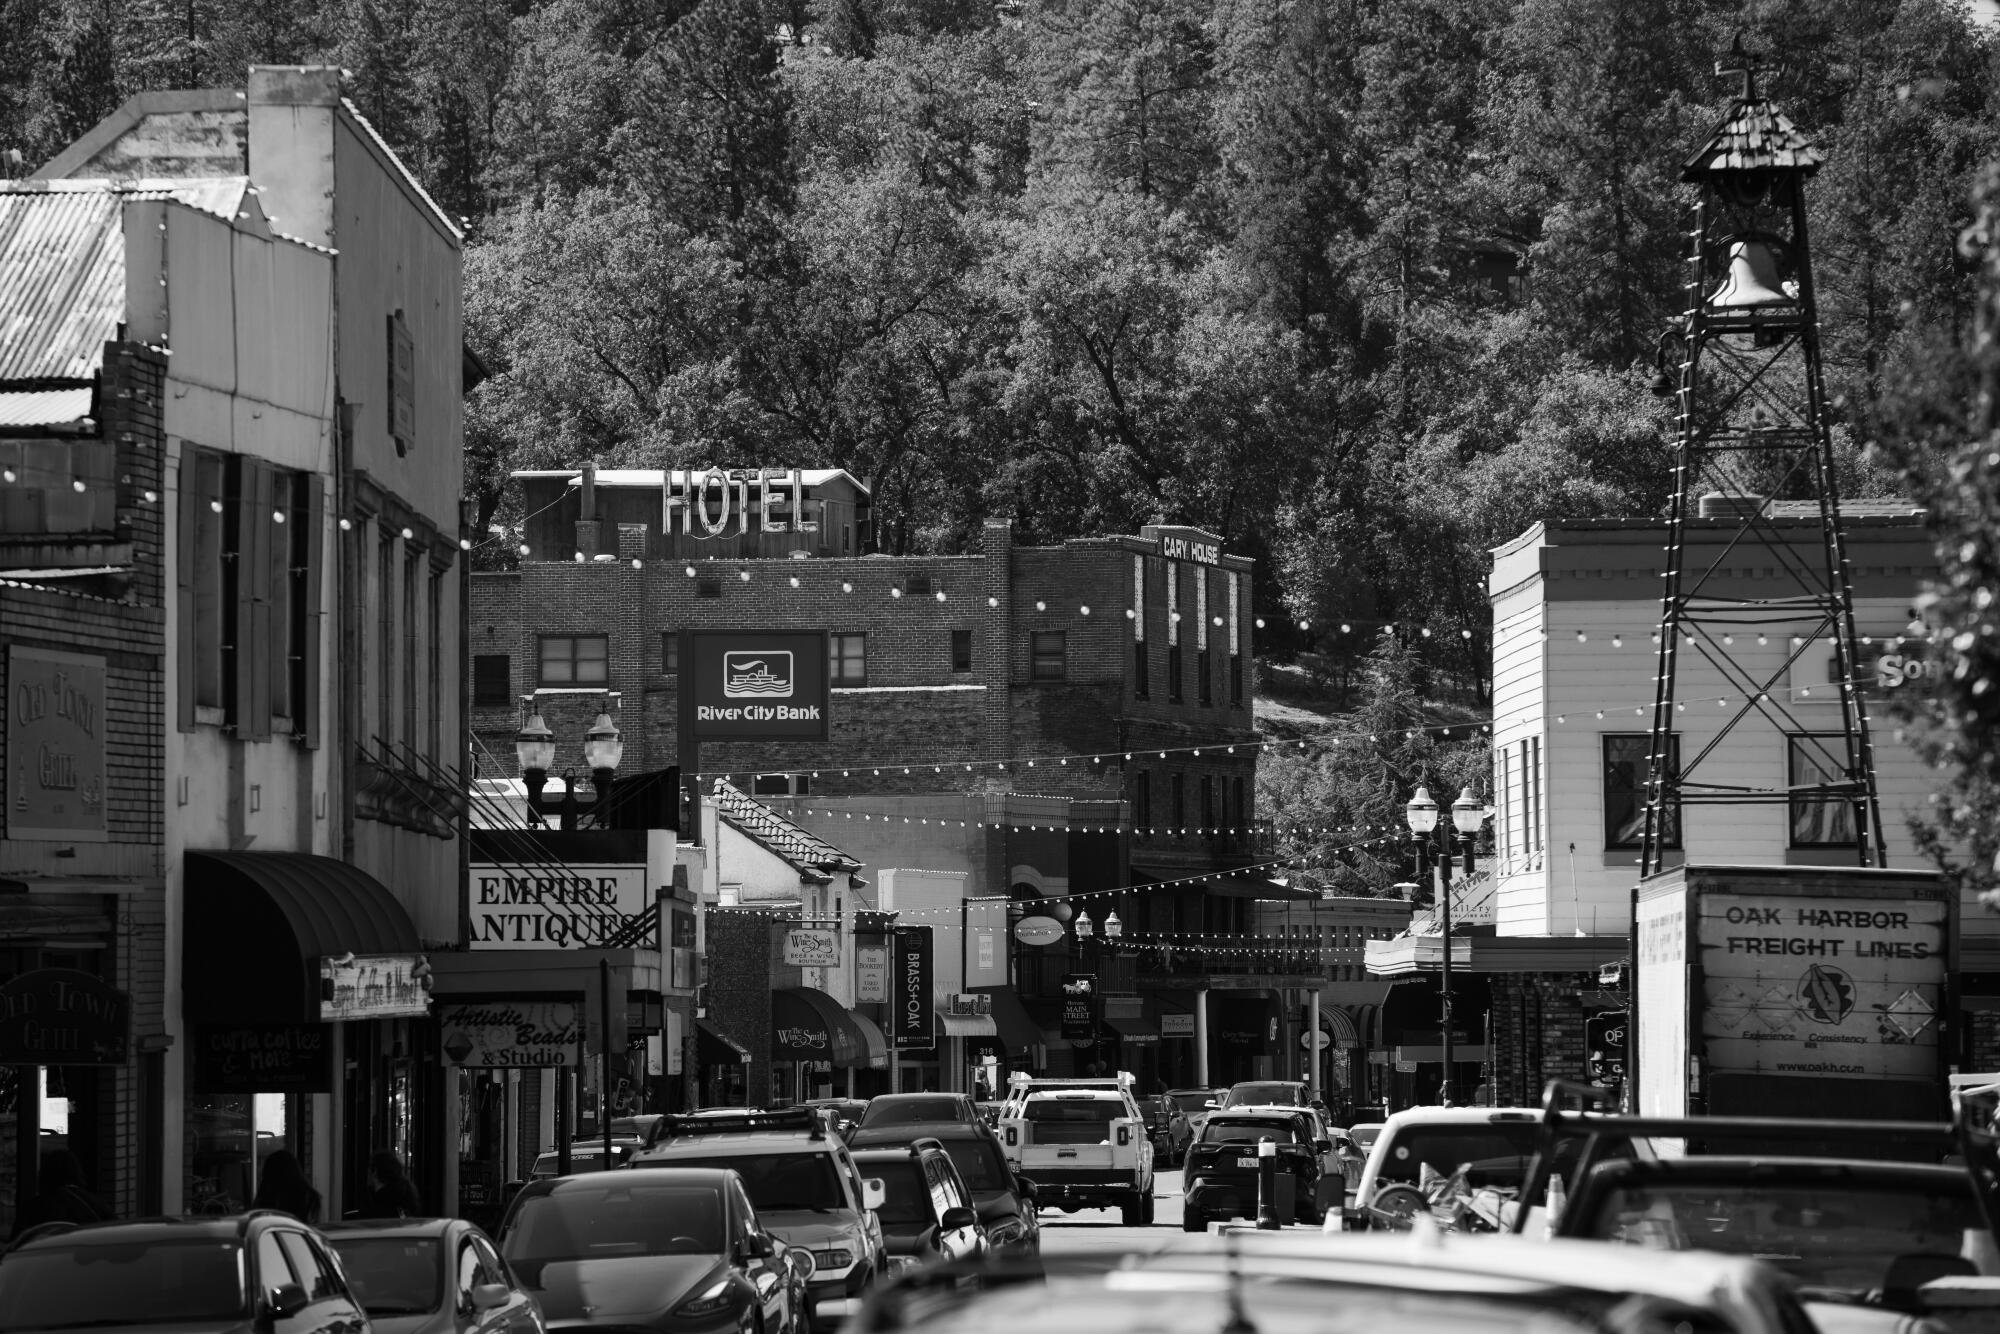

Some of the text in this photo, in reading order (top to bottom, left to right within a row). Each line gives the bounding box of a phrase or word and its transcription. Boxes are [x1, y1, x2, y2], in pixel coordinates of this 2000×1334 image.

[662, 466, 819, 537] HOTEL
[1164, 536, 1218, 566] CARY HOUSE
[697, 705, 821, 721] River City Bank
[477, 877, 618, 905] EMPIRE
[1726, 906, 1909, 929] OAK HARBOR
[791, 935, 833, 953] Wine Smith
[1726, 937, 1929, 959] FREIGHT LINES
[907, 953, 921, 1029] BRASS+OAK
[441, 1004, 523, 1028] Artistic
[515, 1023, 578, 1046] Beads
[777, 1030, 801, 1044] Wine
[802, 1029, 828, 1049] Smith
[481, 1048, 566, 1067] & Studio
[1775, 1062, 1866, 1074] www.oakh.com
